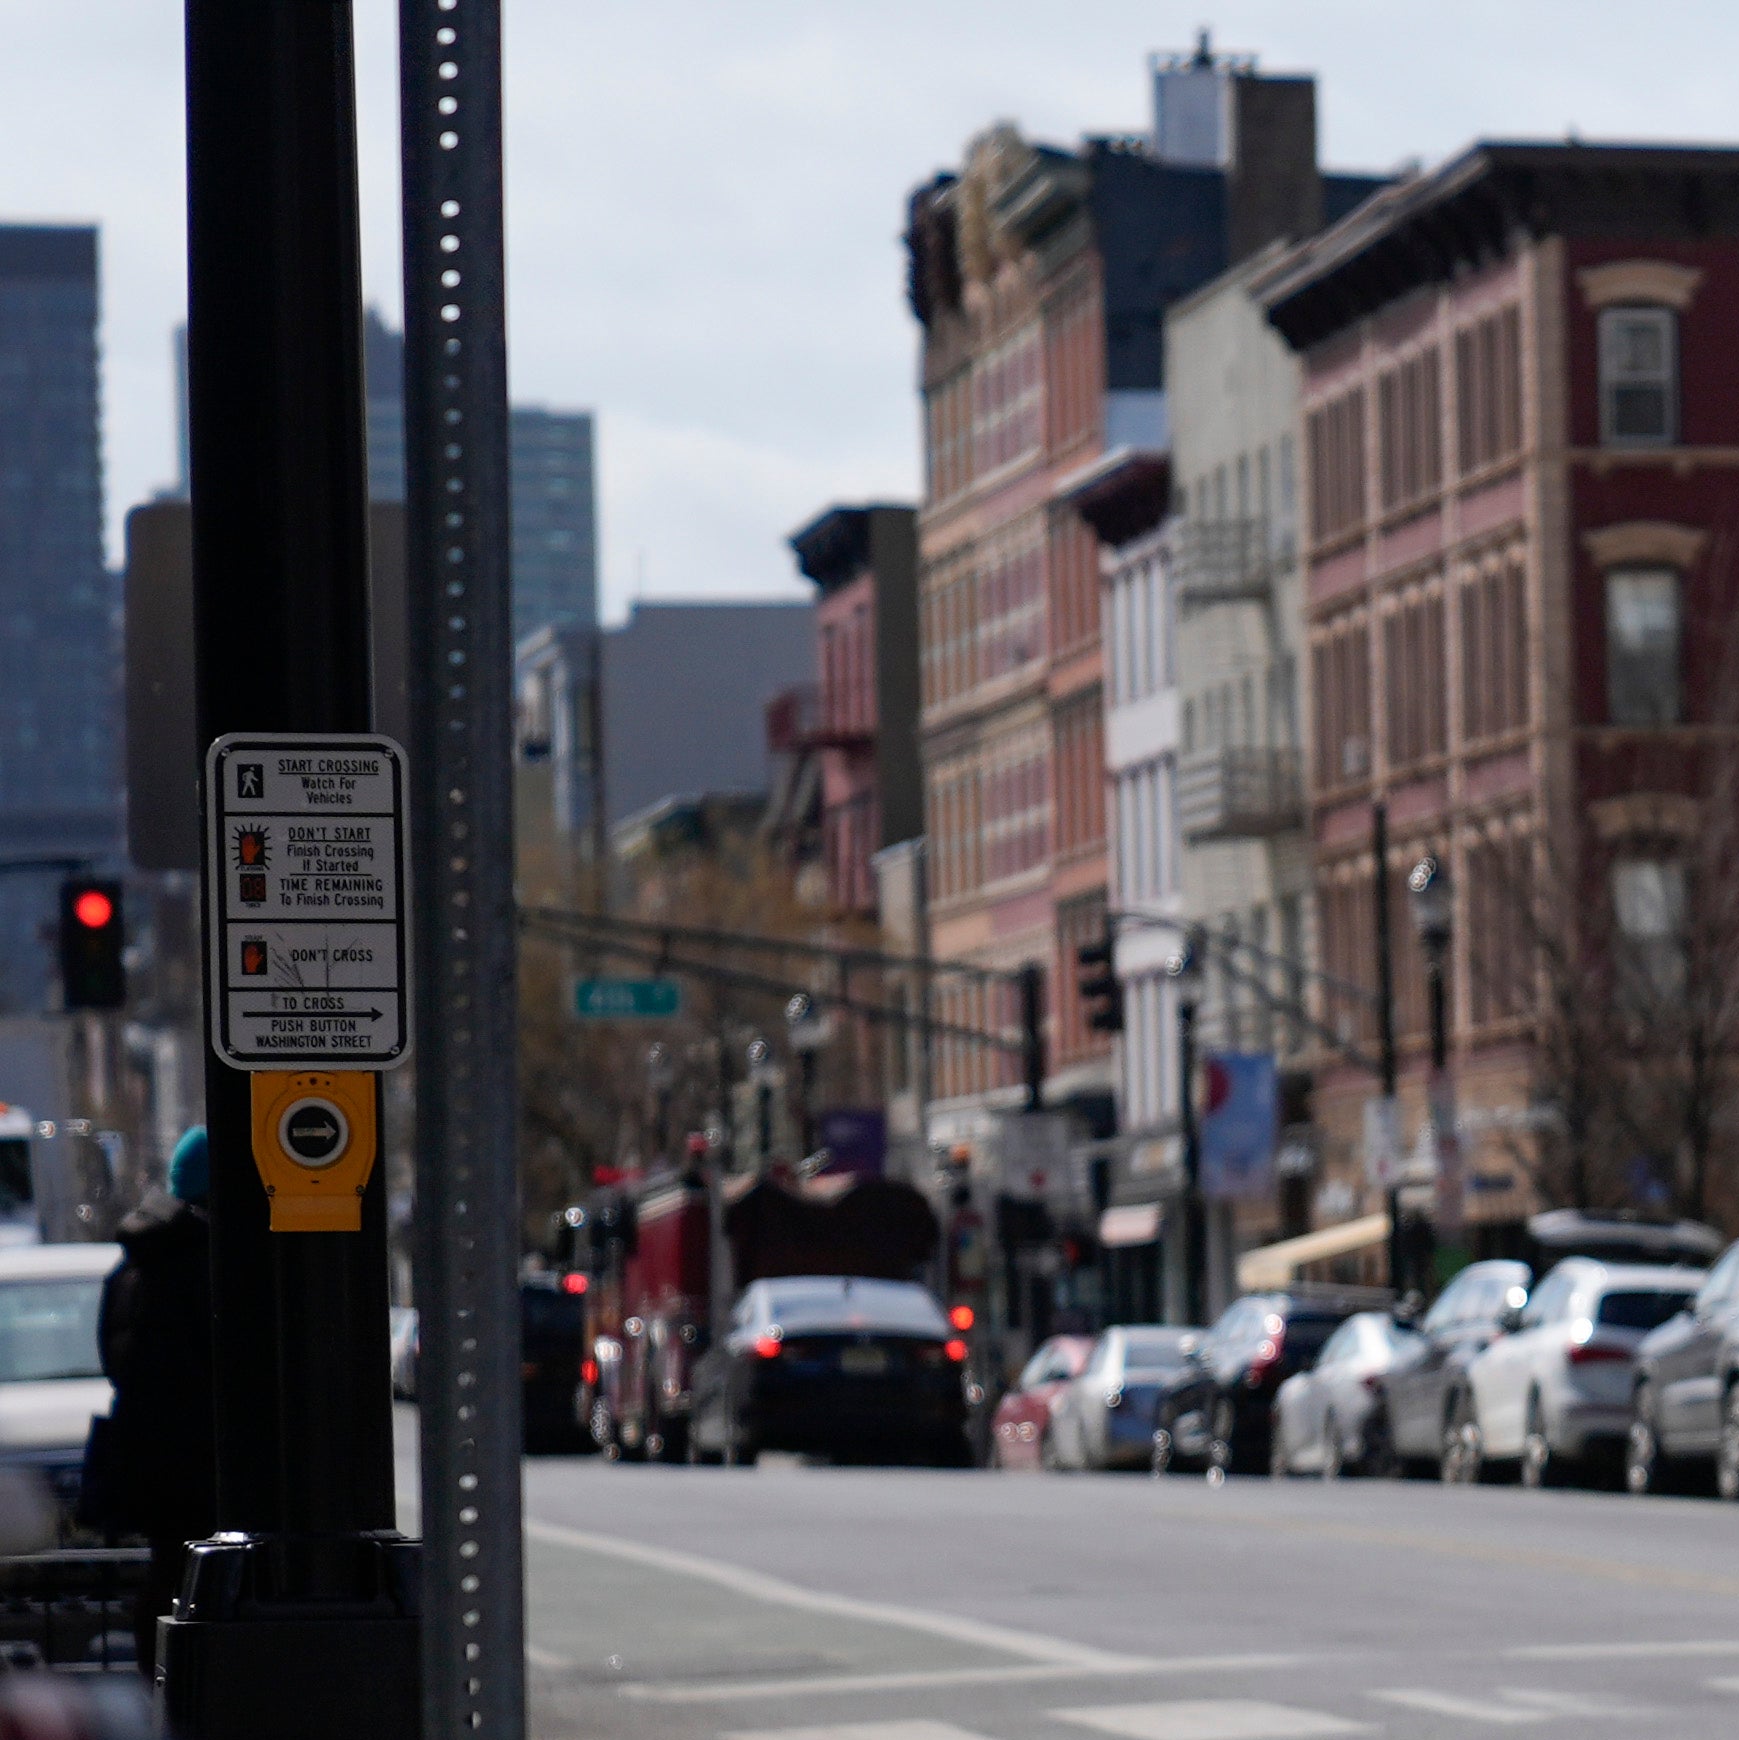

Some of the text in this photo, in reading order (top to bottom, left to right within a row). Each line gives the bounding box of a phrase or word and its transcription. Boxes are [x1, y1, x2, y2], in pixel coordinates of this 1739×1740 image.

[278, 759, 379, 772] START CROSSING
[302, 777, 356, 790] Watch For
[306, 791, 352, 804] Vehicles
[288, 827, 371, 840] DON'T START
[287, 845, 374, 860] Finish Crossing
[302, 859, 359, 872] If Started
[280, 878, 383, 892] TIME REMAINING
[280, 893, 384, 909] To Finish Crossing
[292, 949, 373, 962] DON'T CROSS
[282, 997, 345, 1010] TO CROSS
[271, 1019, 356, 1032] PUSH BUTTON
[255, 1035, 372, 1048] WASHINGTON STREET
